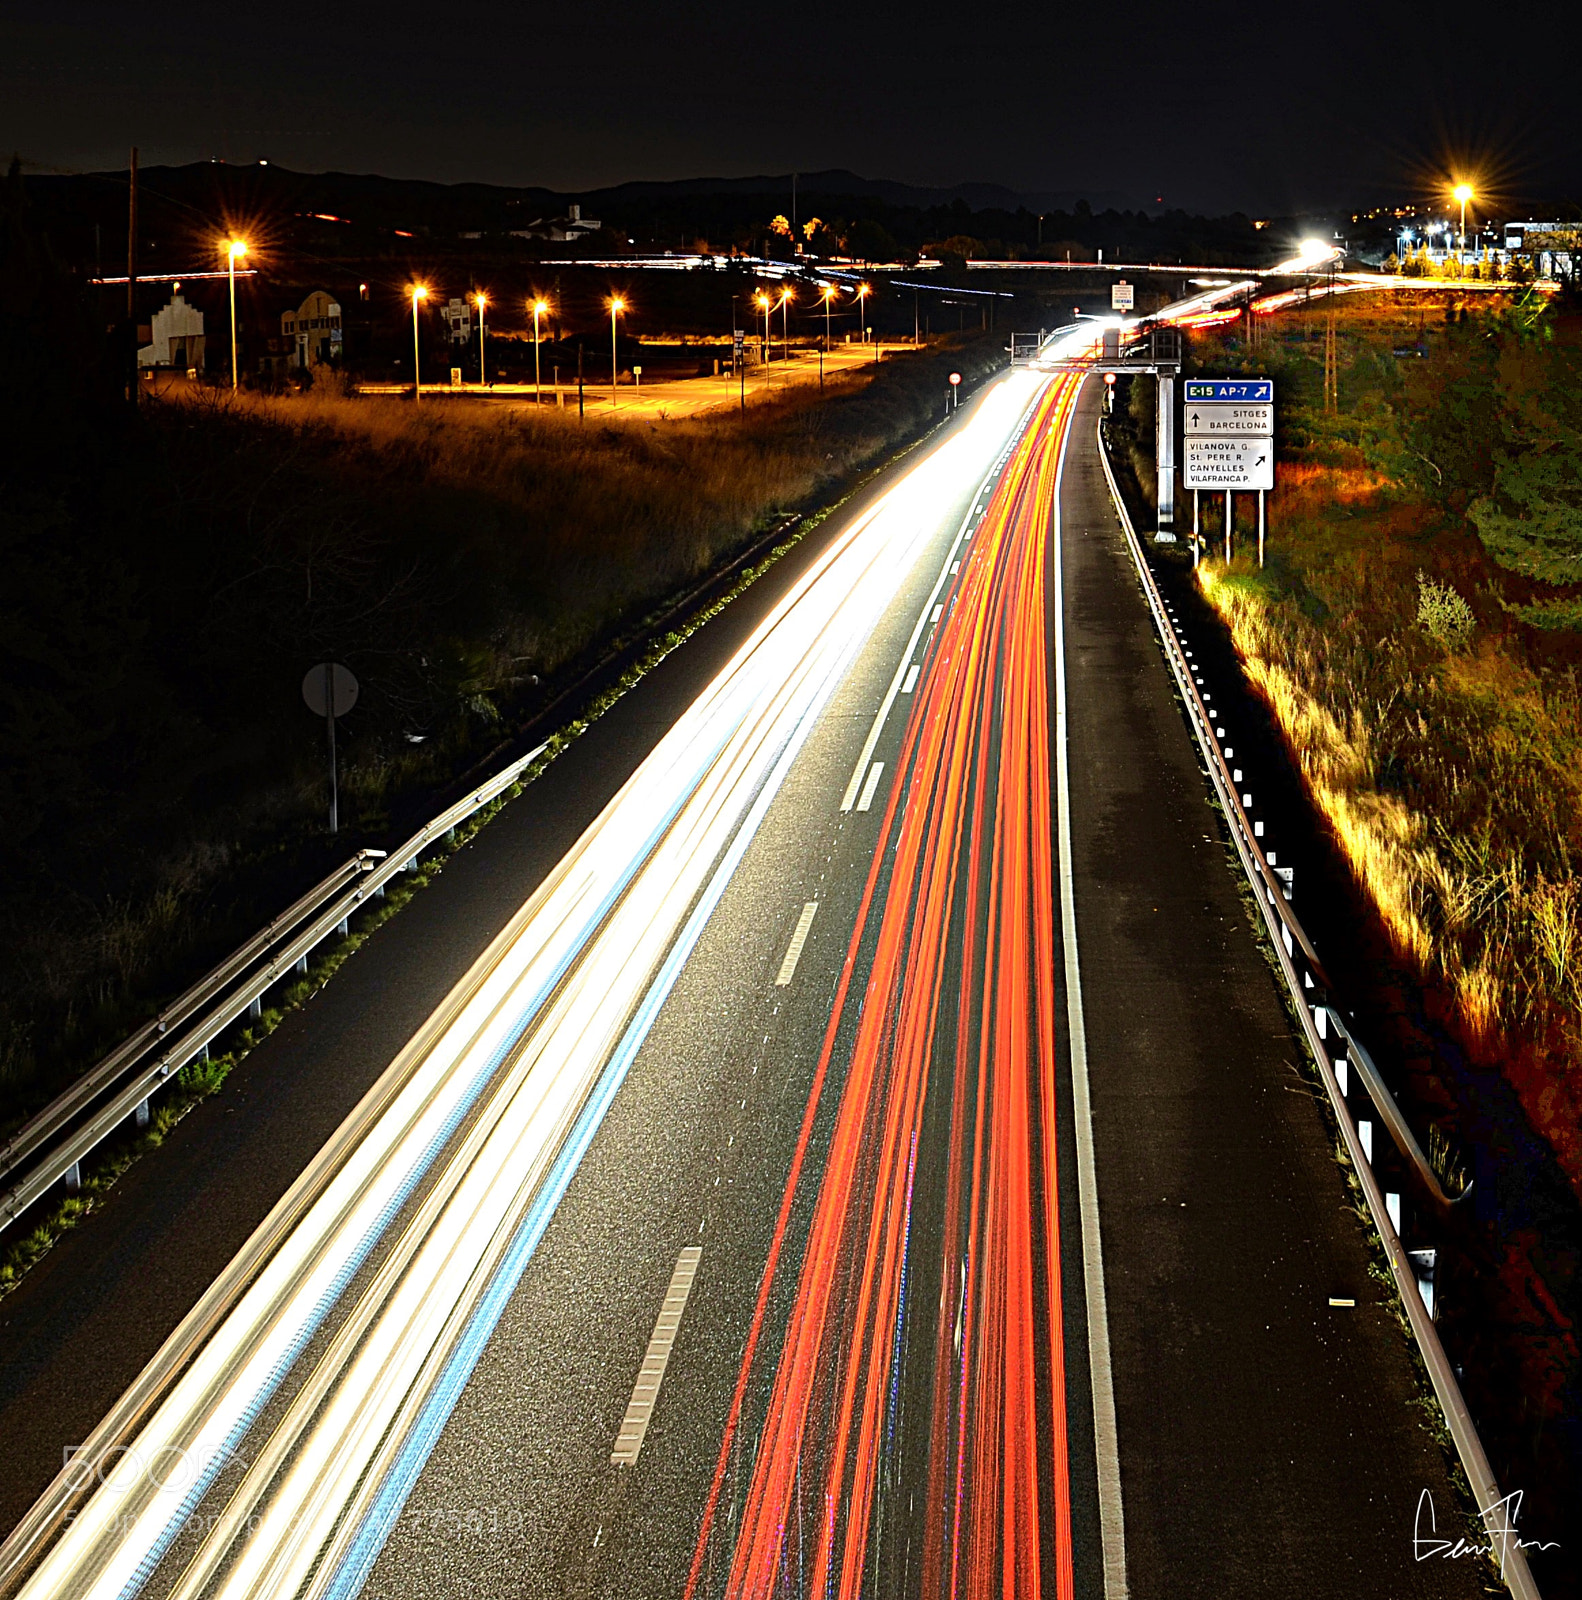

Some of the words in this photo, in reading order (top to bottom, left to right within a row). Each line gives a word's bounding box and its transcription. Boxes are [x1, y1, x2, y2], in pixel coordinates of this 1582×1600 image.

[1190, 387, 1213, 396] E-15
[1219, 387, 1248, 396] AP-7
[1233, 410, 1267, 418] SITGES
